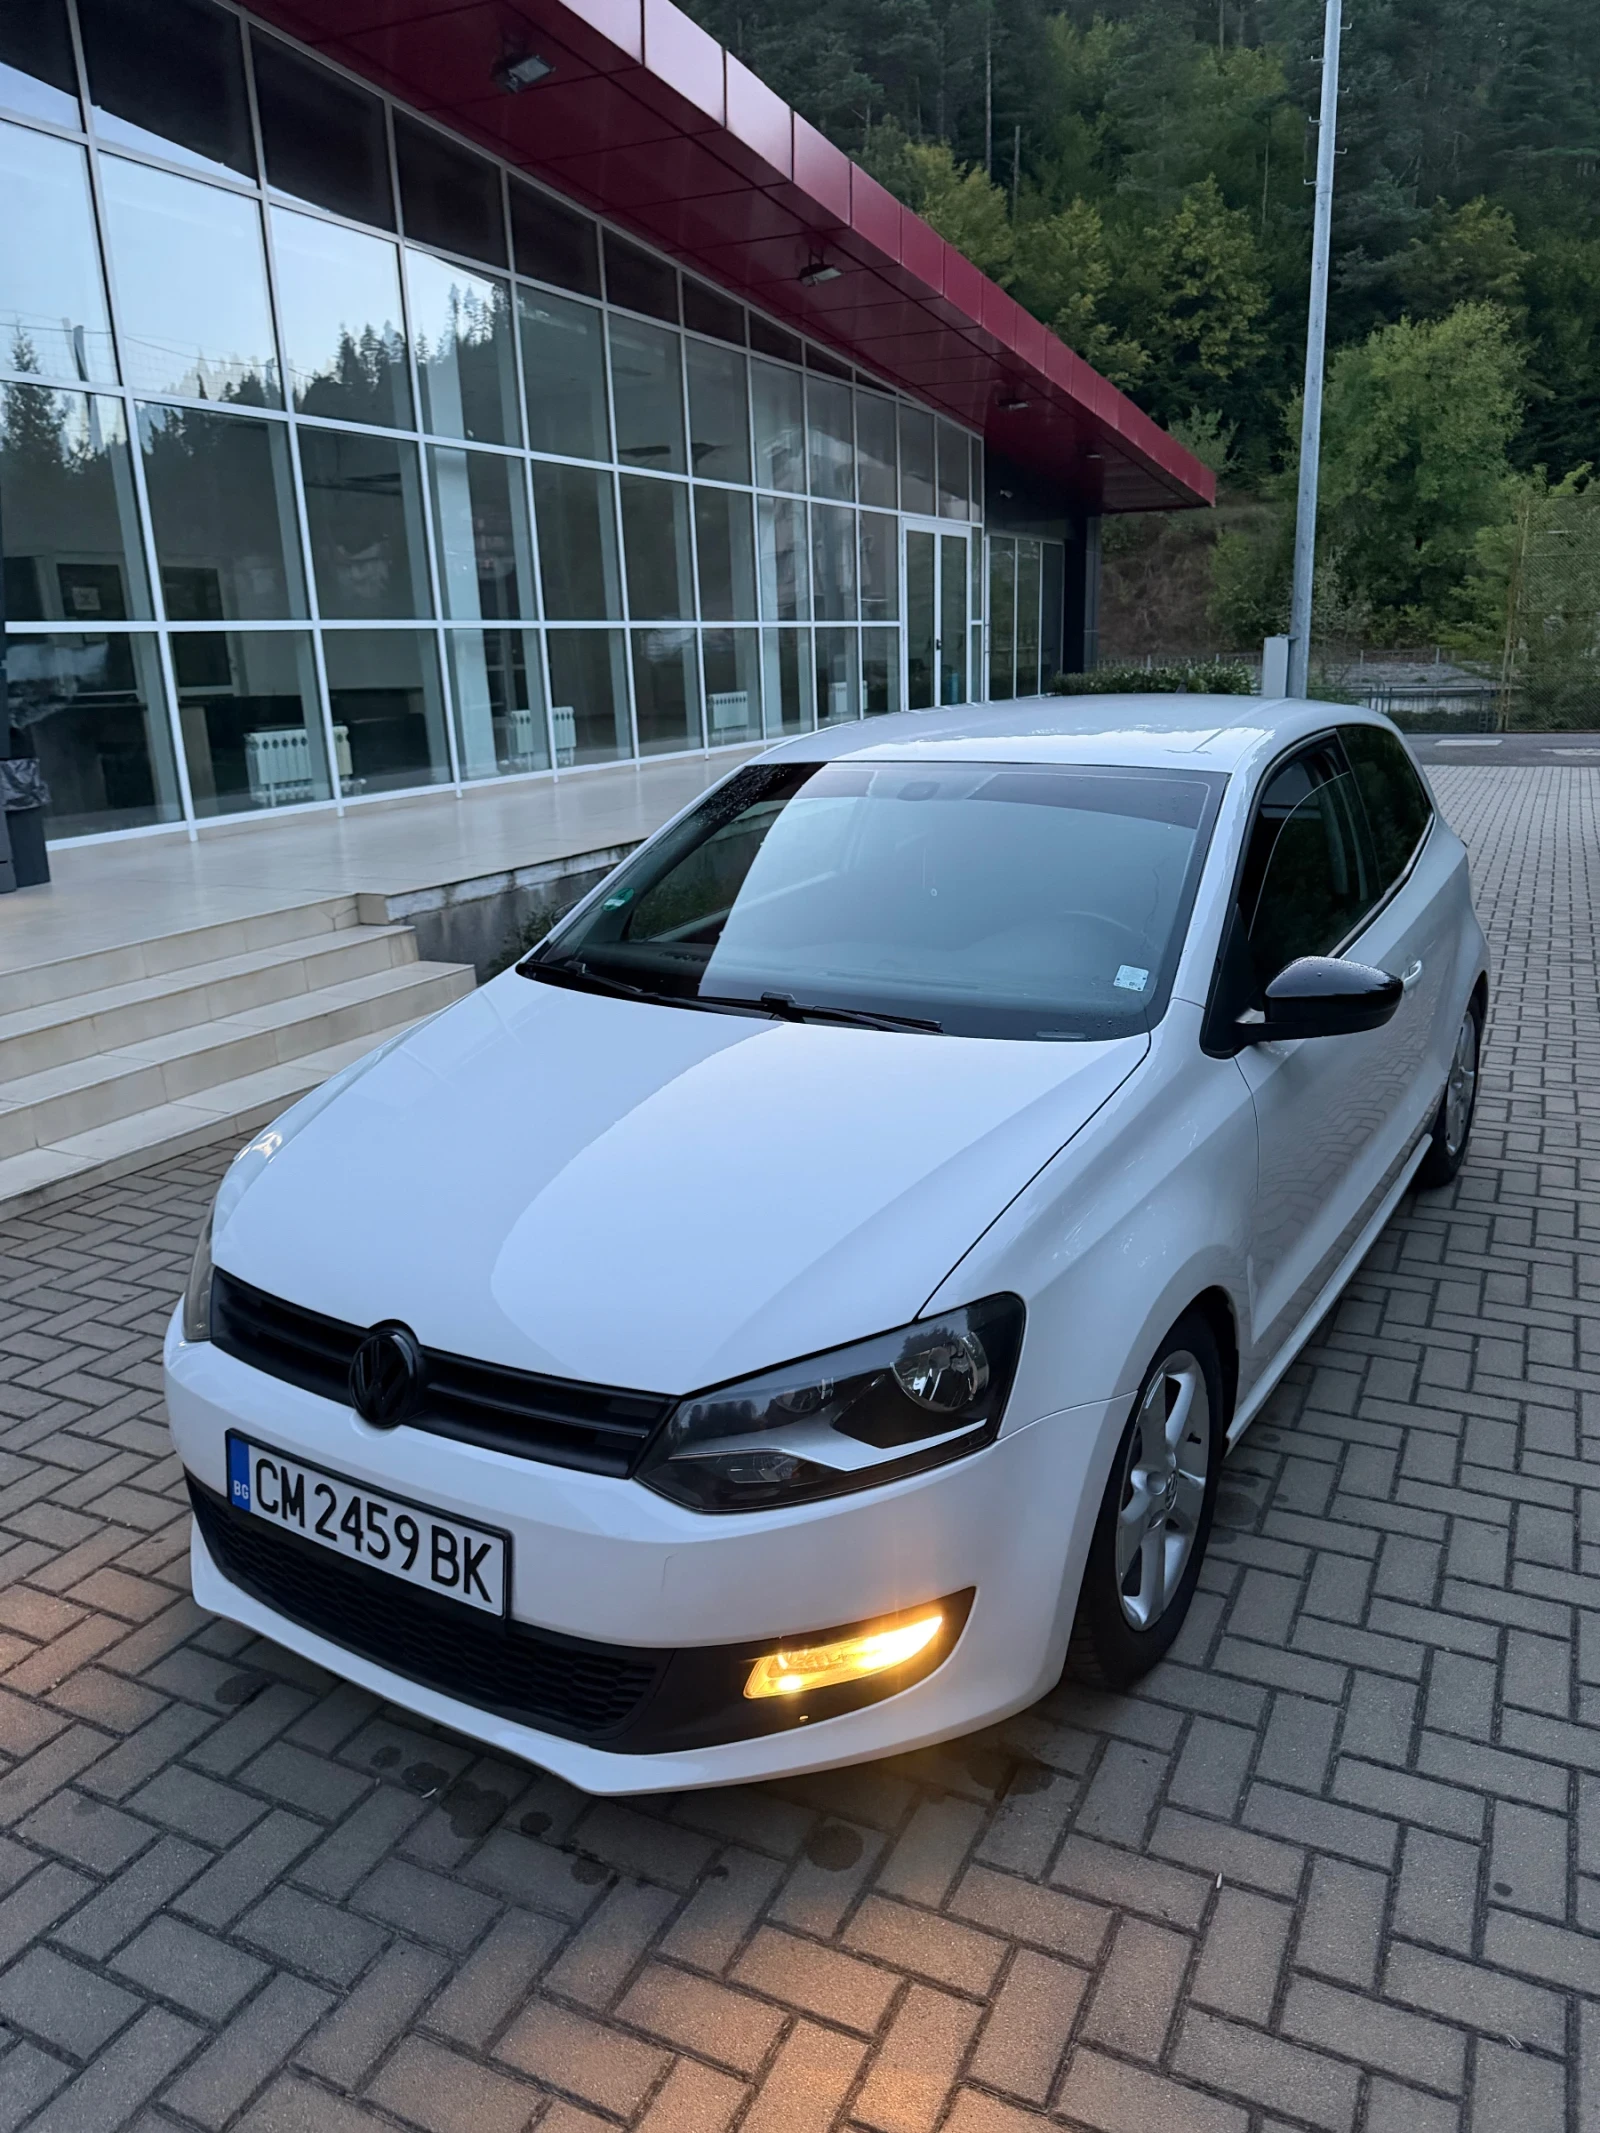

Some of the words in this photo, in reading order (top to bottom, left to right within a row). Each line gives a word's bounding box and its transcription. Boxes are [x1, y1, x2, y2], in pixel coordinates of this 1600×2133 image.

[233, 1479, 249, 1500] BG
[255, 1458, 306, 1529] CM
[314, 1483, 420, 1571] 2459
[430, 1524, 493, 1604] BK
